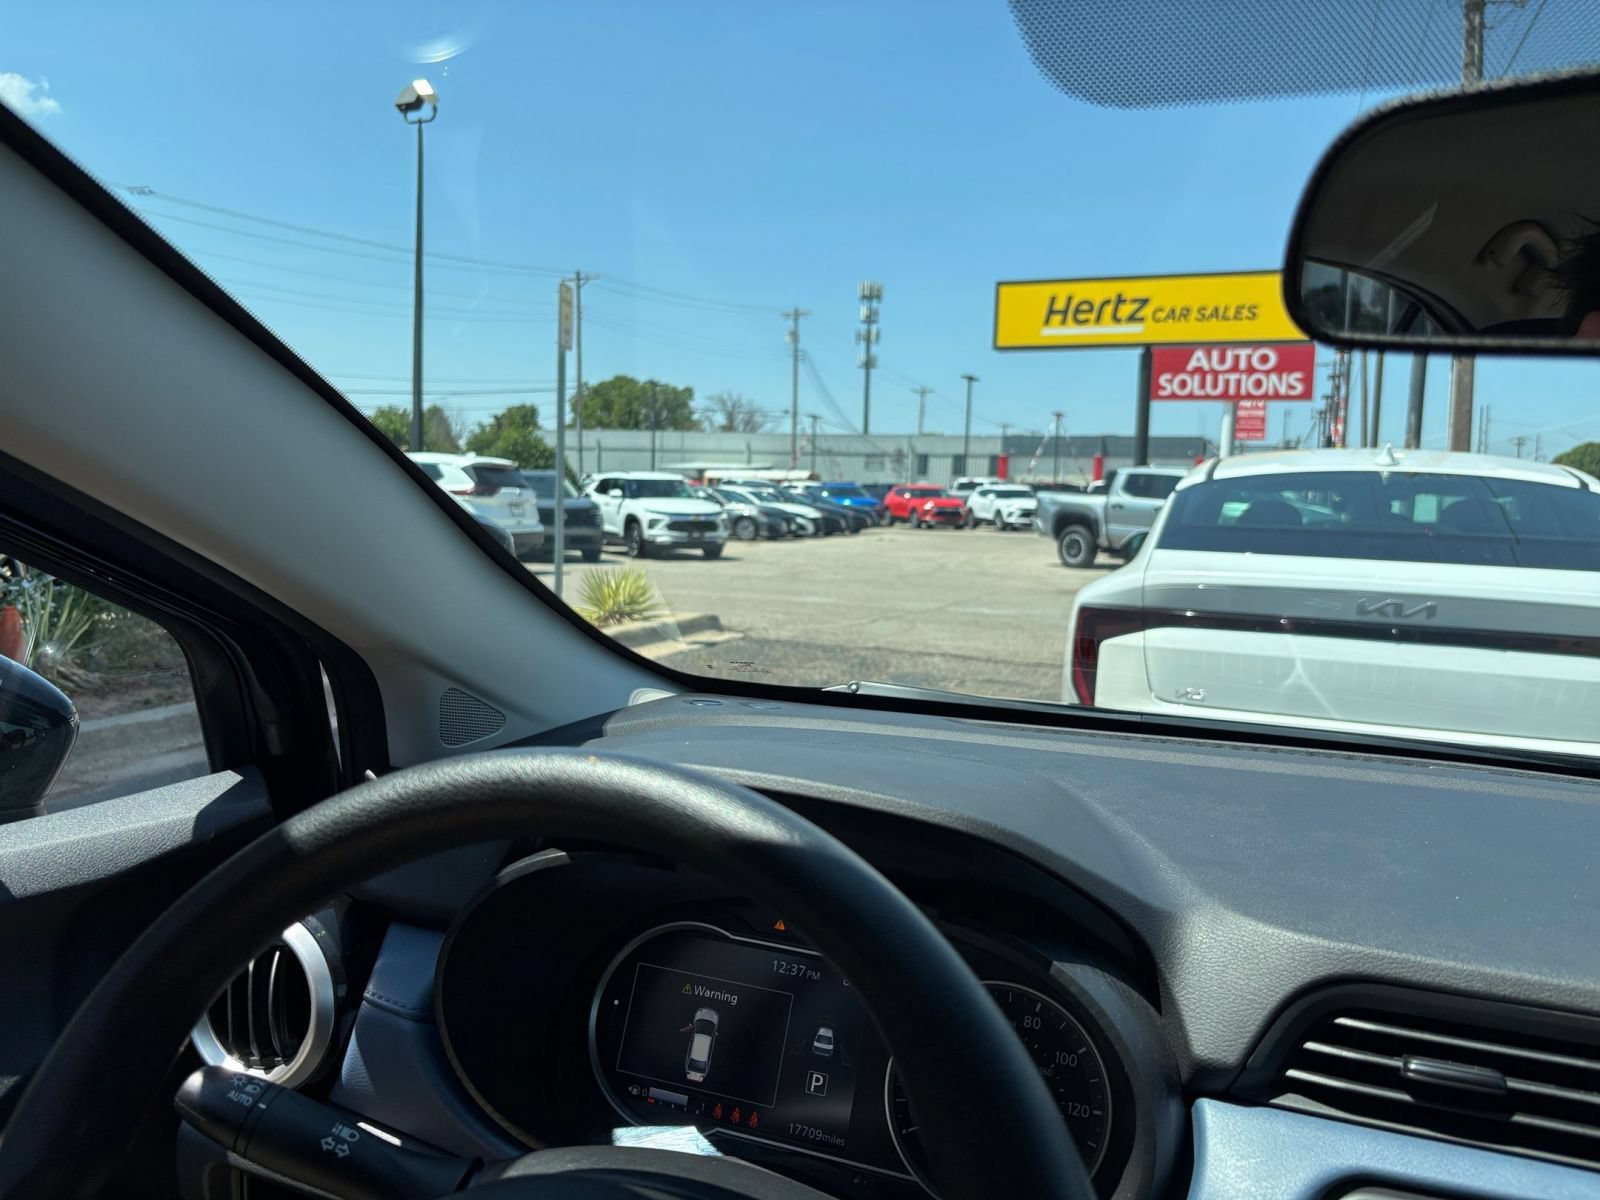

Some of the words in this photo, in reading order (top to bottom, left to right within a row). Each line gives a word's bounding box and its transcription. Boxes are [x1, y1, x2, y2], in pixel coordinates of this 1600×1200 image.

[1043, 293, 1151, 326] Hertz
[1151, 307, 1191, 323] CAR
[1195, 303, 1260, 322] SALES
[1186, 347, 1278, 372] AUTO
[1157, 371, 1304, 397] SOLUTIONS
[773, 960, 806, 976] 12:37
[806, 970, 821, 981] PM
[694, 985, 738, 1005] Warning
[1023, 1015, 1041, 1030] 80
[1055, 1050, 1078, 1067] 100
[810, 1073, 824, 1092] P
[227, 1090, 253, 1106] AUTO
[1067, 1102, 1090, 1118] 120
